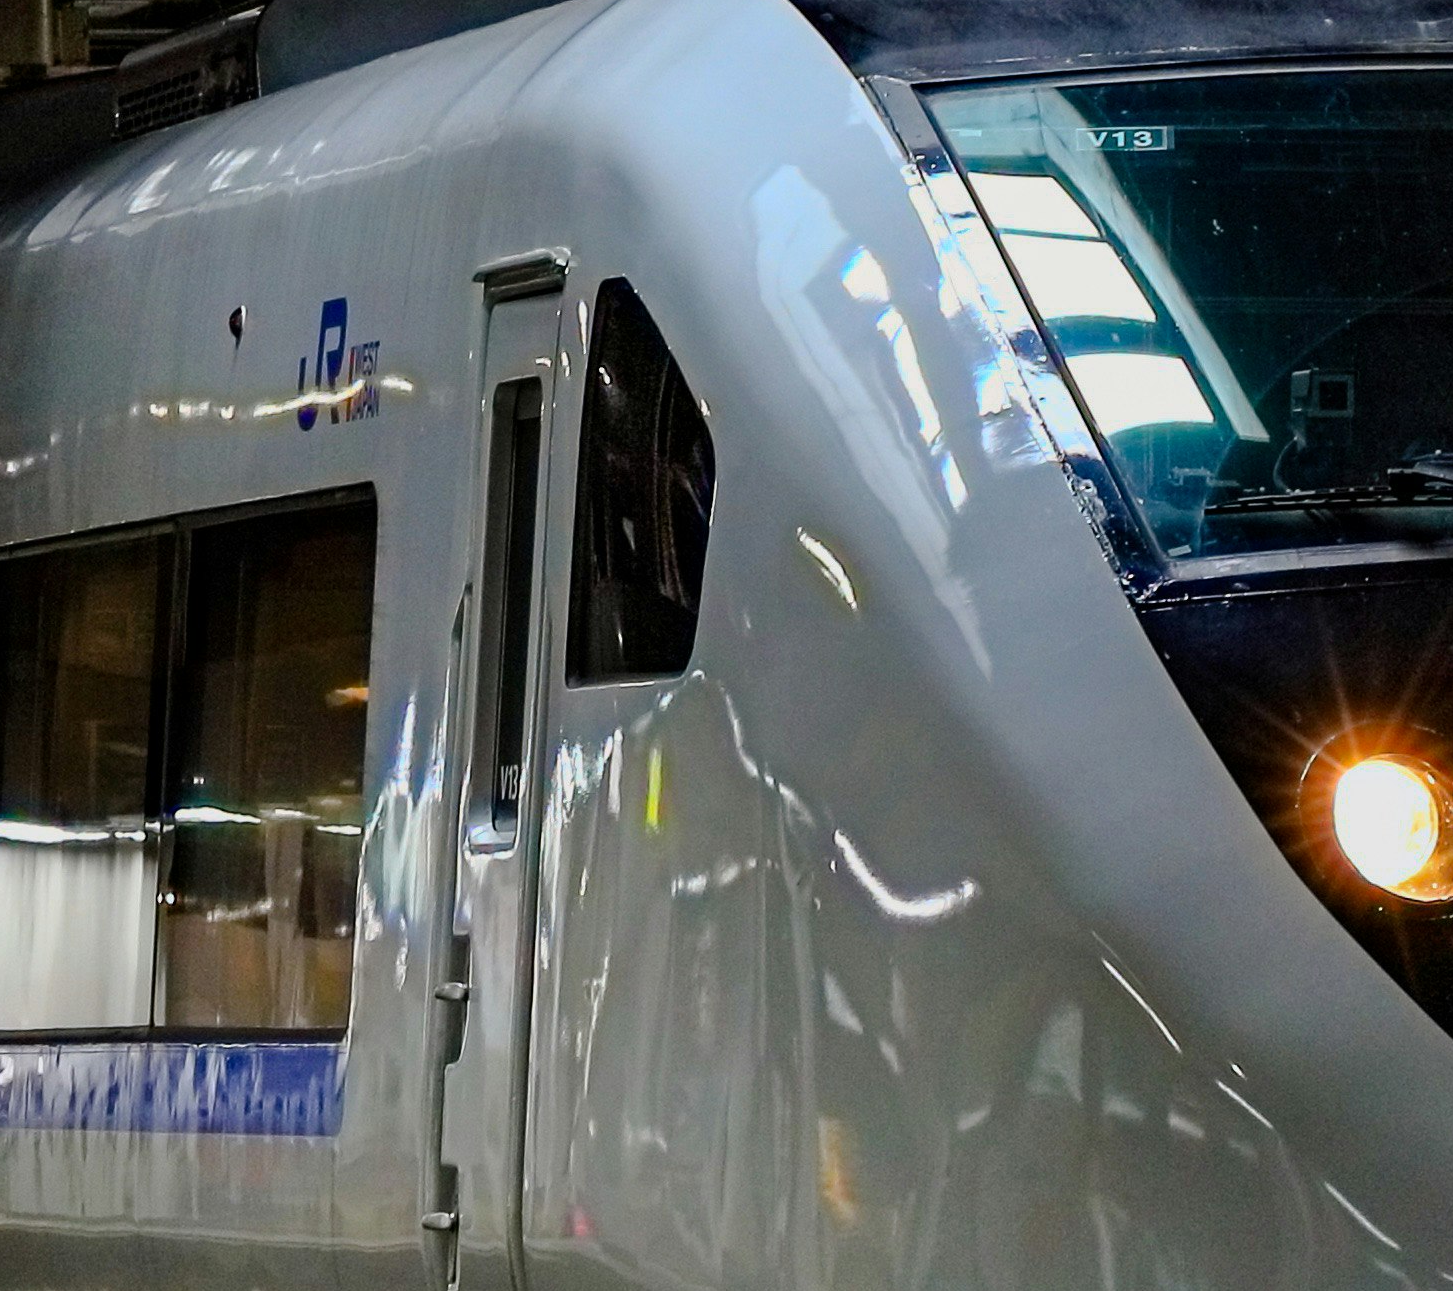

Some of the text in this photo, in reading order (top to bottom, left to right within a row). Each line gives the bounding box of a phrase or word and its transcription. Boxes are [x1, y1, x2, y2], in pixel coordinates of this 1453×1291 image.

[1087, 130, 1154, 148] V13
[298, 297, 348, 432] JR
[500, 764, 519, 801] V13
